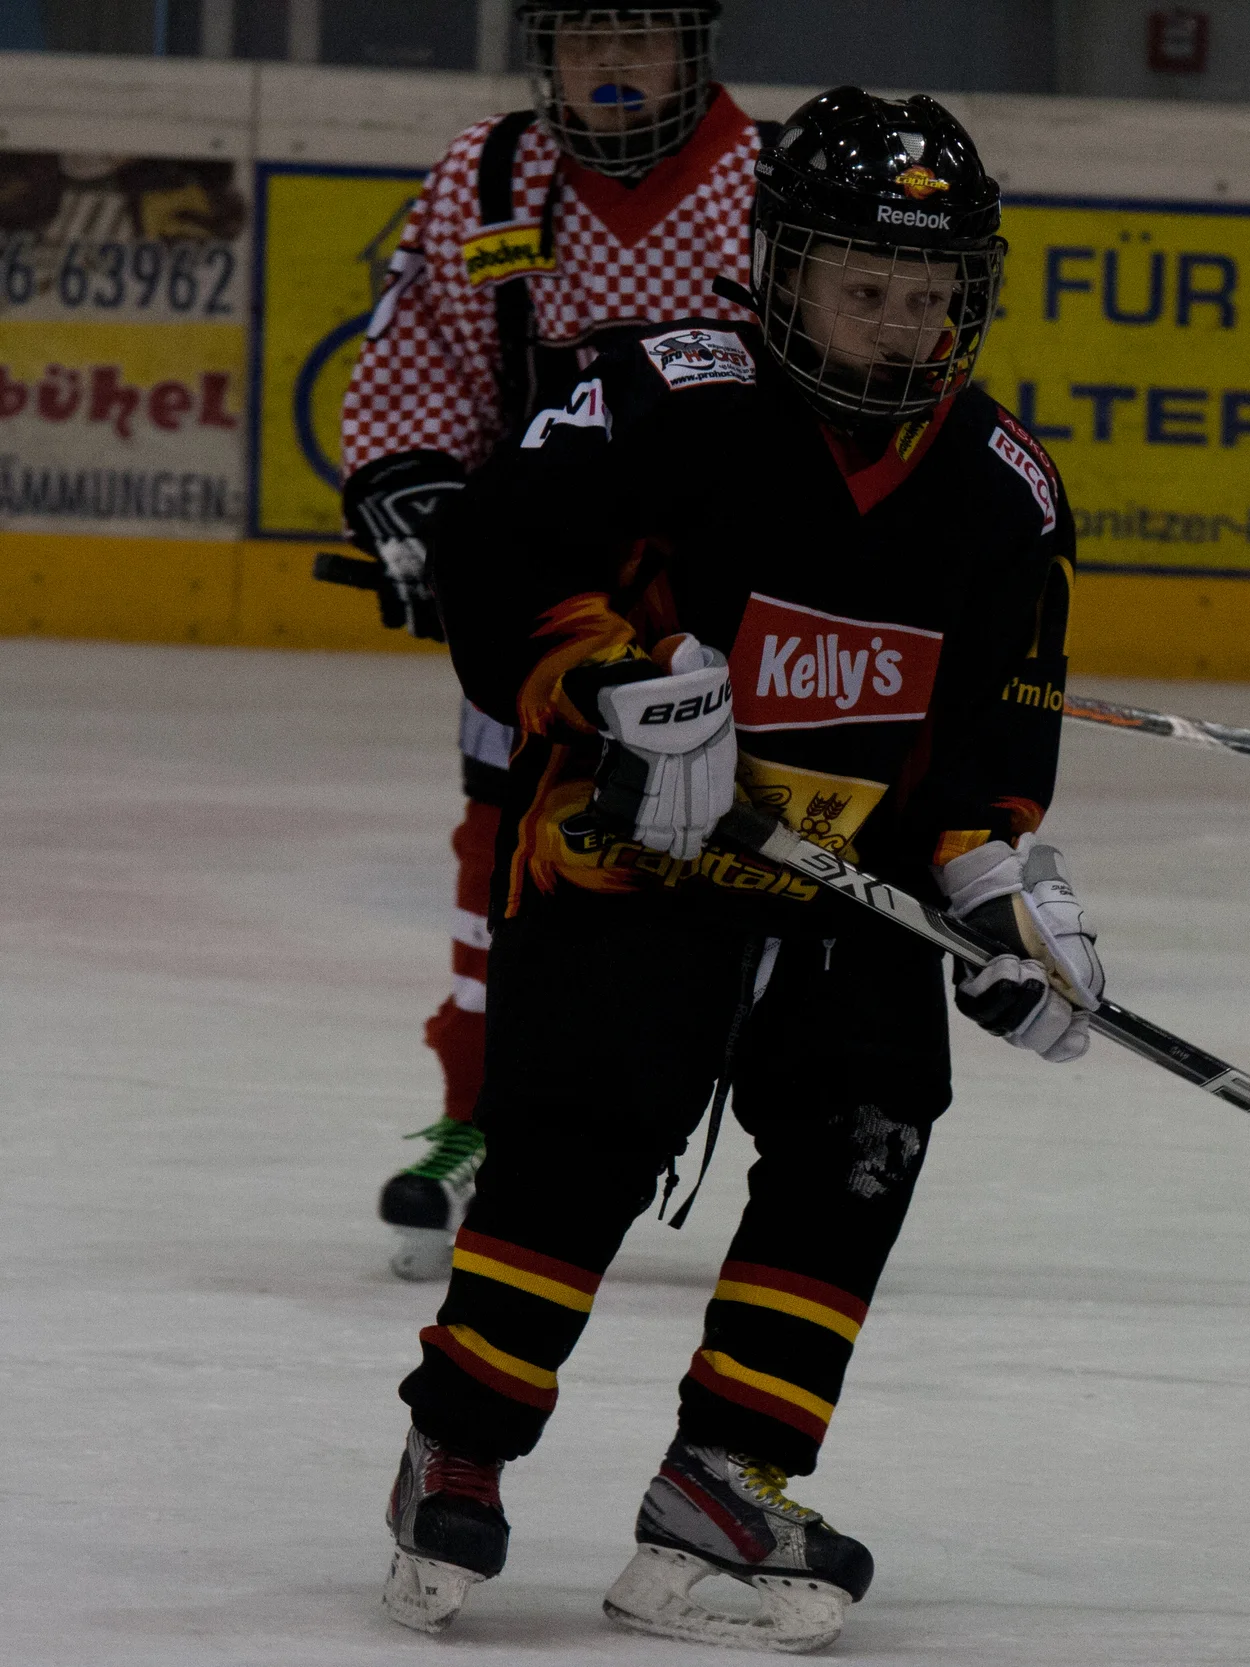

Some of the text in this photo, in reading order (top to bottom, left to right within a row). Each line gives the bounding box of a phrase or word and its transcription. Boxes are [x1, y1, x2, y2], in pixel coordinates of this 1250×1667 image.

[877, 204, 952, 231] Reebok
[0, 242, 235, 316] 6 63962
[1044, 230, 1238, 329] FÜR
[756, 633, 903, 710] Kelly's
